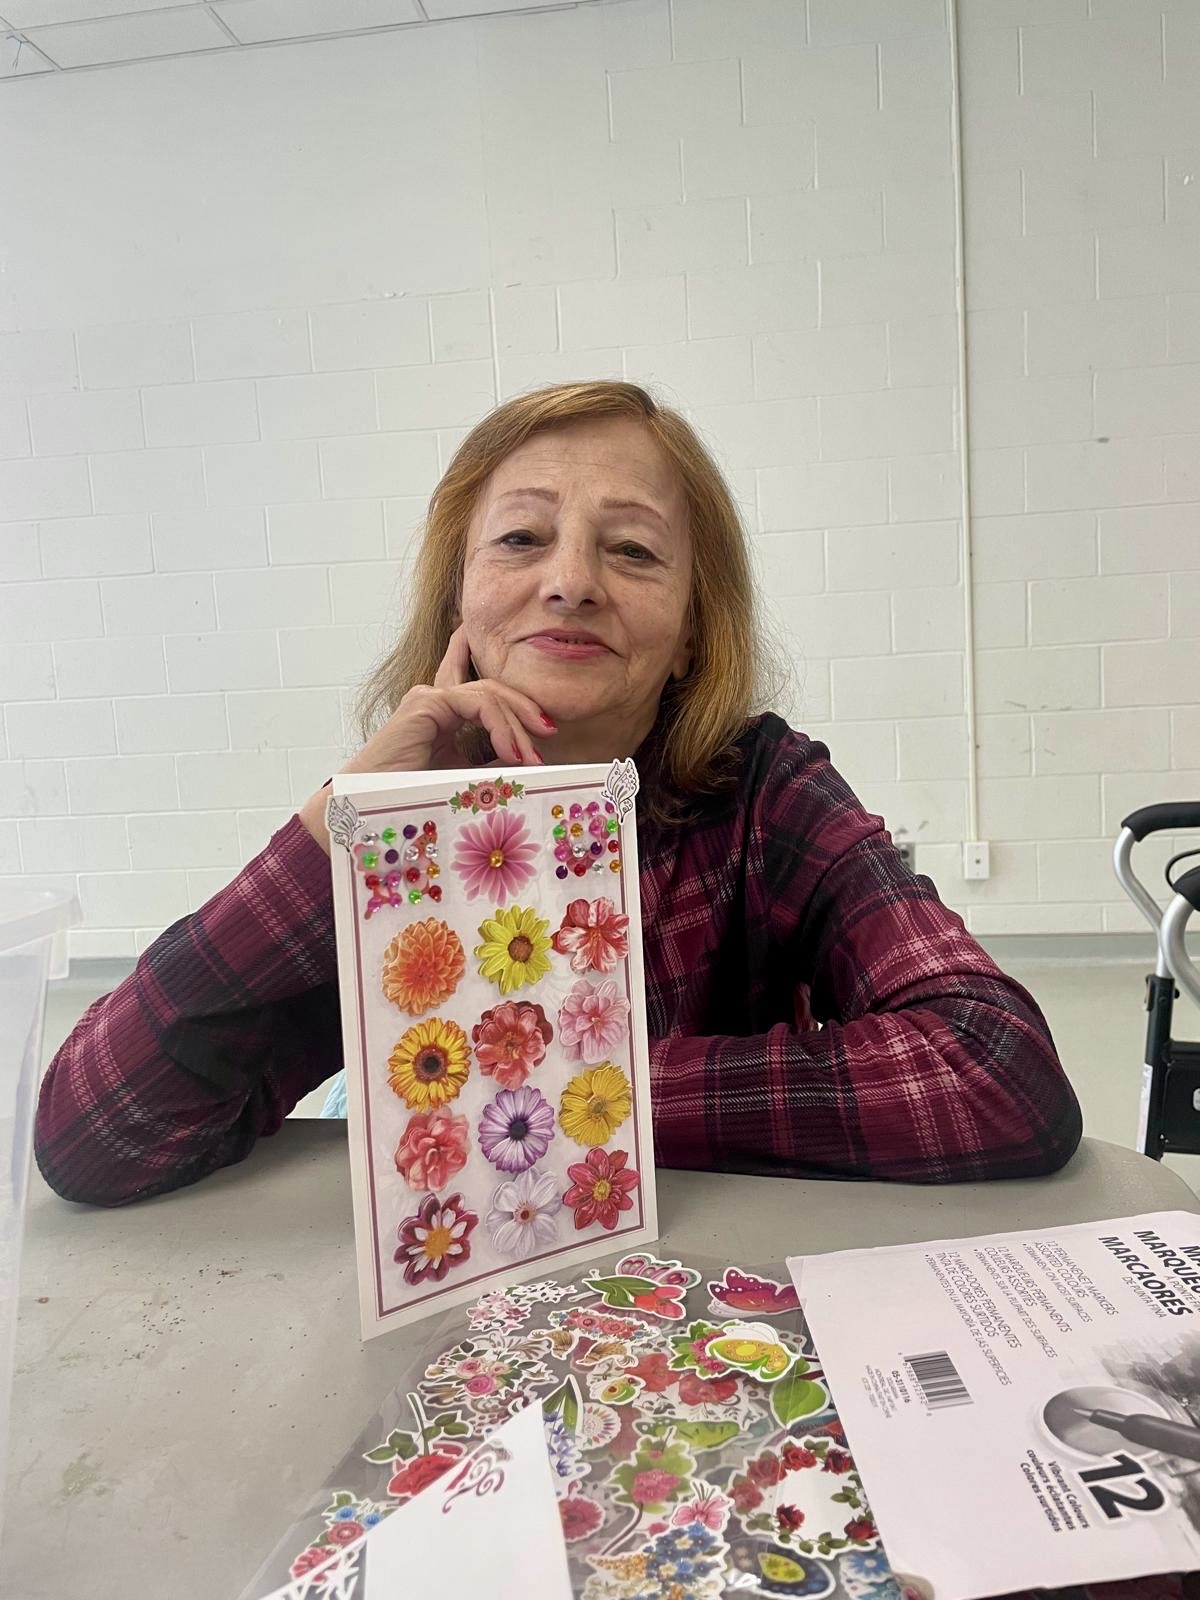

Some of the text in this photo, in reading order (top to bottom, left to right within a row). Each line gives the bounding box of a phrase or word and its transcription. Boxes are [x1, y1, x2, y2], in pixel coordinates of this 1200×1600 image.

[945, 1266, 960, 1275] DE
[984, 1247, 1013, 1273] COULEURS
[1035, 1242, 1090, 1298] ASSORTED COLOURS
[1098, 1237, 1193, 1316] MARCAORES
[951, 1276, 978, 1303] COLORES
[1046, 1272, 1060, 1282] ON
[1052, 1282, 1072, 1296] MOST
[1030, 1289, 1073, 1332] PERMANENTS
[1065, 1297, 1093, 1323] SURFACES
[1085, 1286, 1119, 1316] MARKERS
[1121, 1277, 1167, 1318] DE PUNTA FINA
[969, 1328, 982, 1337] DE
[970, 1304, 999, 1337] SURTIDOS
[980, 1299, 1022, 1348] PERMANENTES
[995, 1280, 1009, 1289] SUR
[1021, 1317, 1037, 1328] DES
[1030, 1329, 1058, 1358] SURFACES
[975, 1337, 990, 1348] LAS
[1027, 1449, 1050, 1483] couleurs
[1020, 1462, 1062, 1532] Colores surtidos
[1078, 1454, 1165, 1518] 12
[1066, 1494, 1090, 1529] Colours
